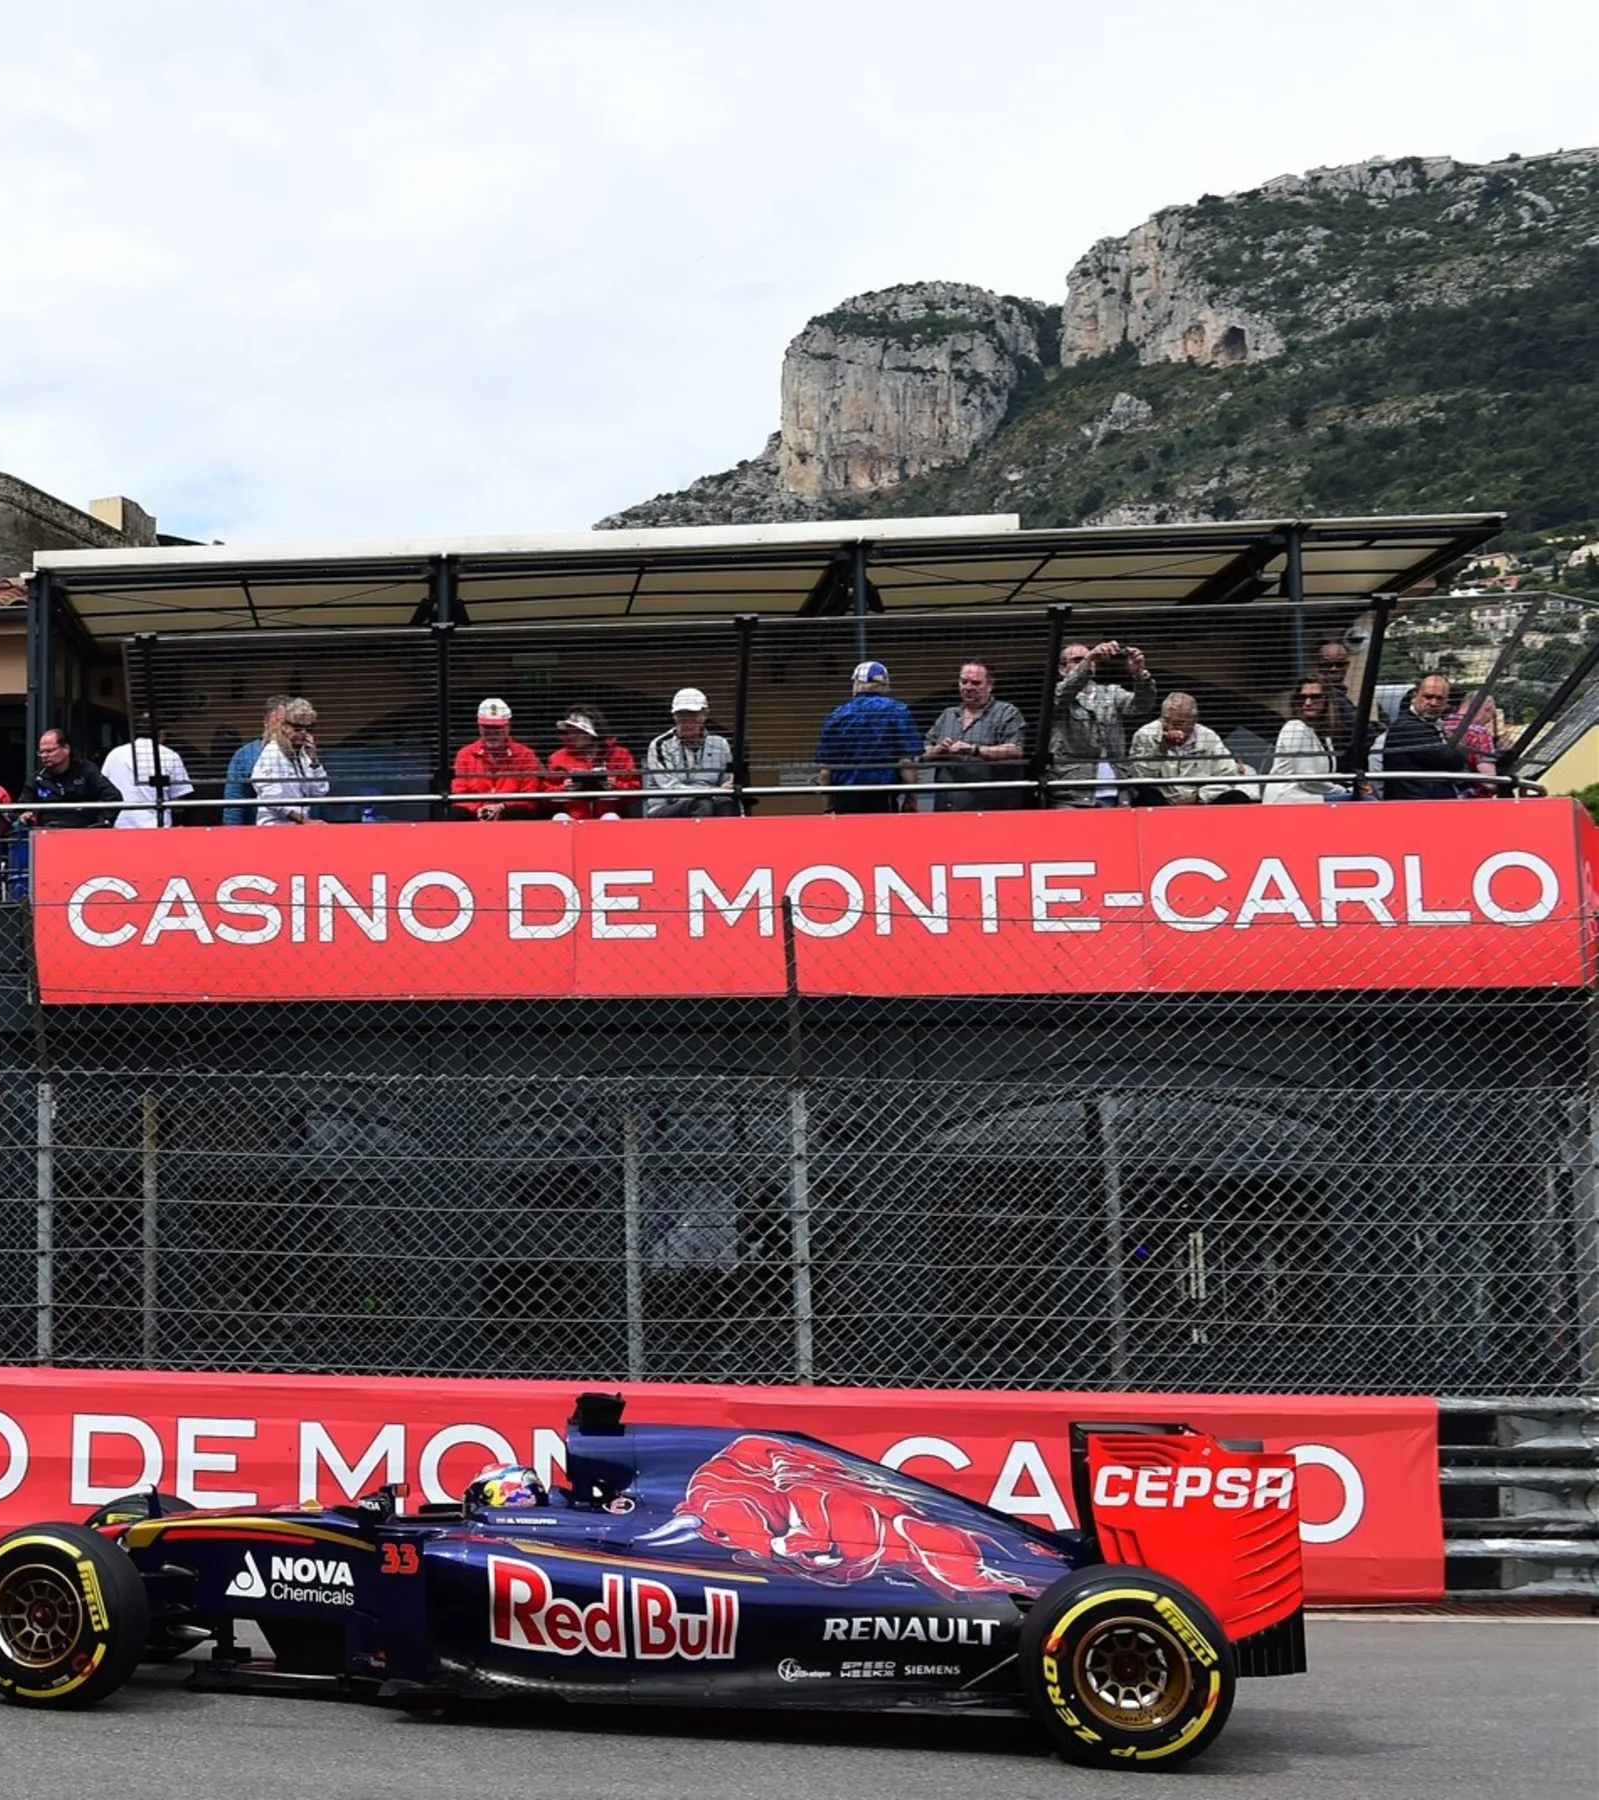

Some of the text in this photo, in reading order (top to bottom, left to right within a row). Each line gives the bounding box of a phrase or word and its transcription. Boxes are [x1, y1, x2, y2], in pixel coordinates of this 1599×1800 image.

[67, 869, 476, 947] CASINO
[506, 868, 658, 942] DE
[687, 850, 1560, 939] MONTE-CARLO
[70, 1412, 258, 1507] DE
[1093, 1465, 1295, 1509] CEPSA
[271, 1555, 354, 1587] NOVA
[381, 1543, 420, 1574] 33
[77, 1560, 110, 1632] PIRELLI
[270, 1582, 355, 1606] Chemicals
[488, 1554, 739, 1660] Red Bull
[822, 1616, 1000, 1646] RENAULT
[1153, 1596, 1219, 1668] PIRELLI
[904, 1664, 961, 1676] SIEMENS
[1043, 1655, 1103, 1745] ZERO
